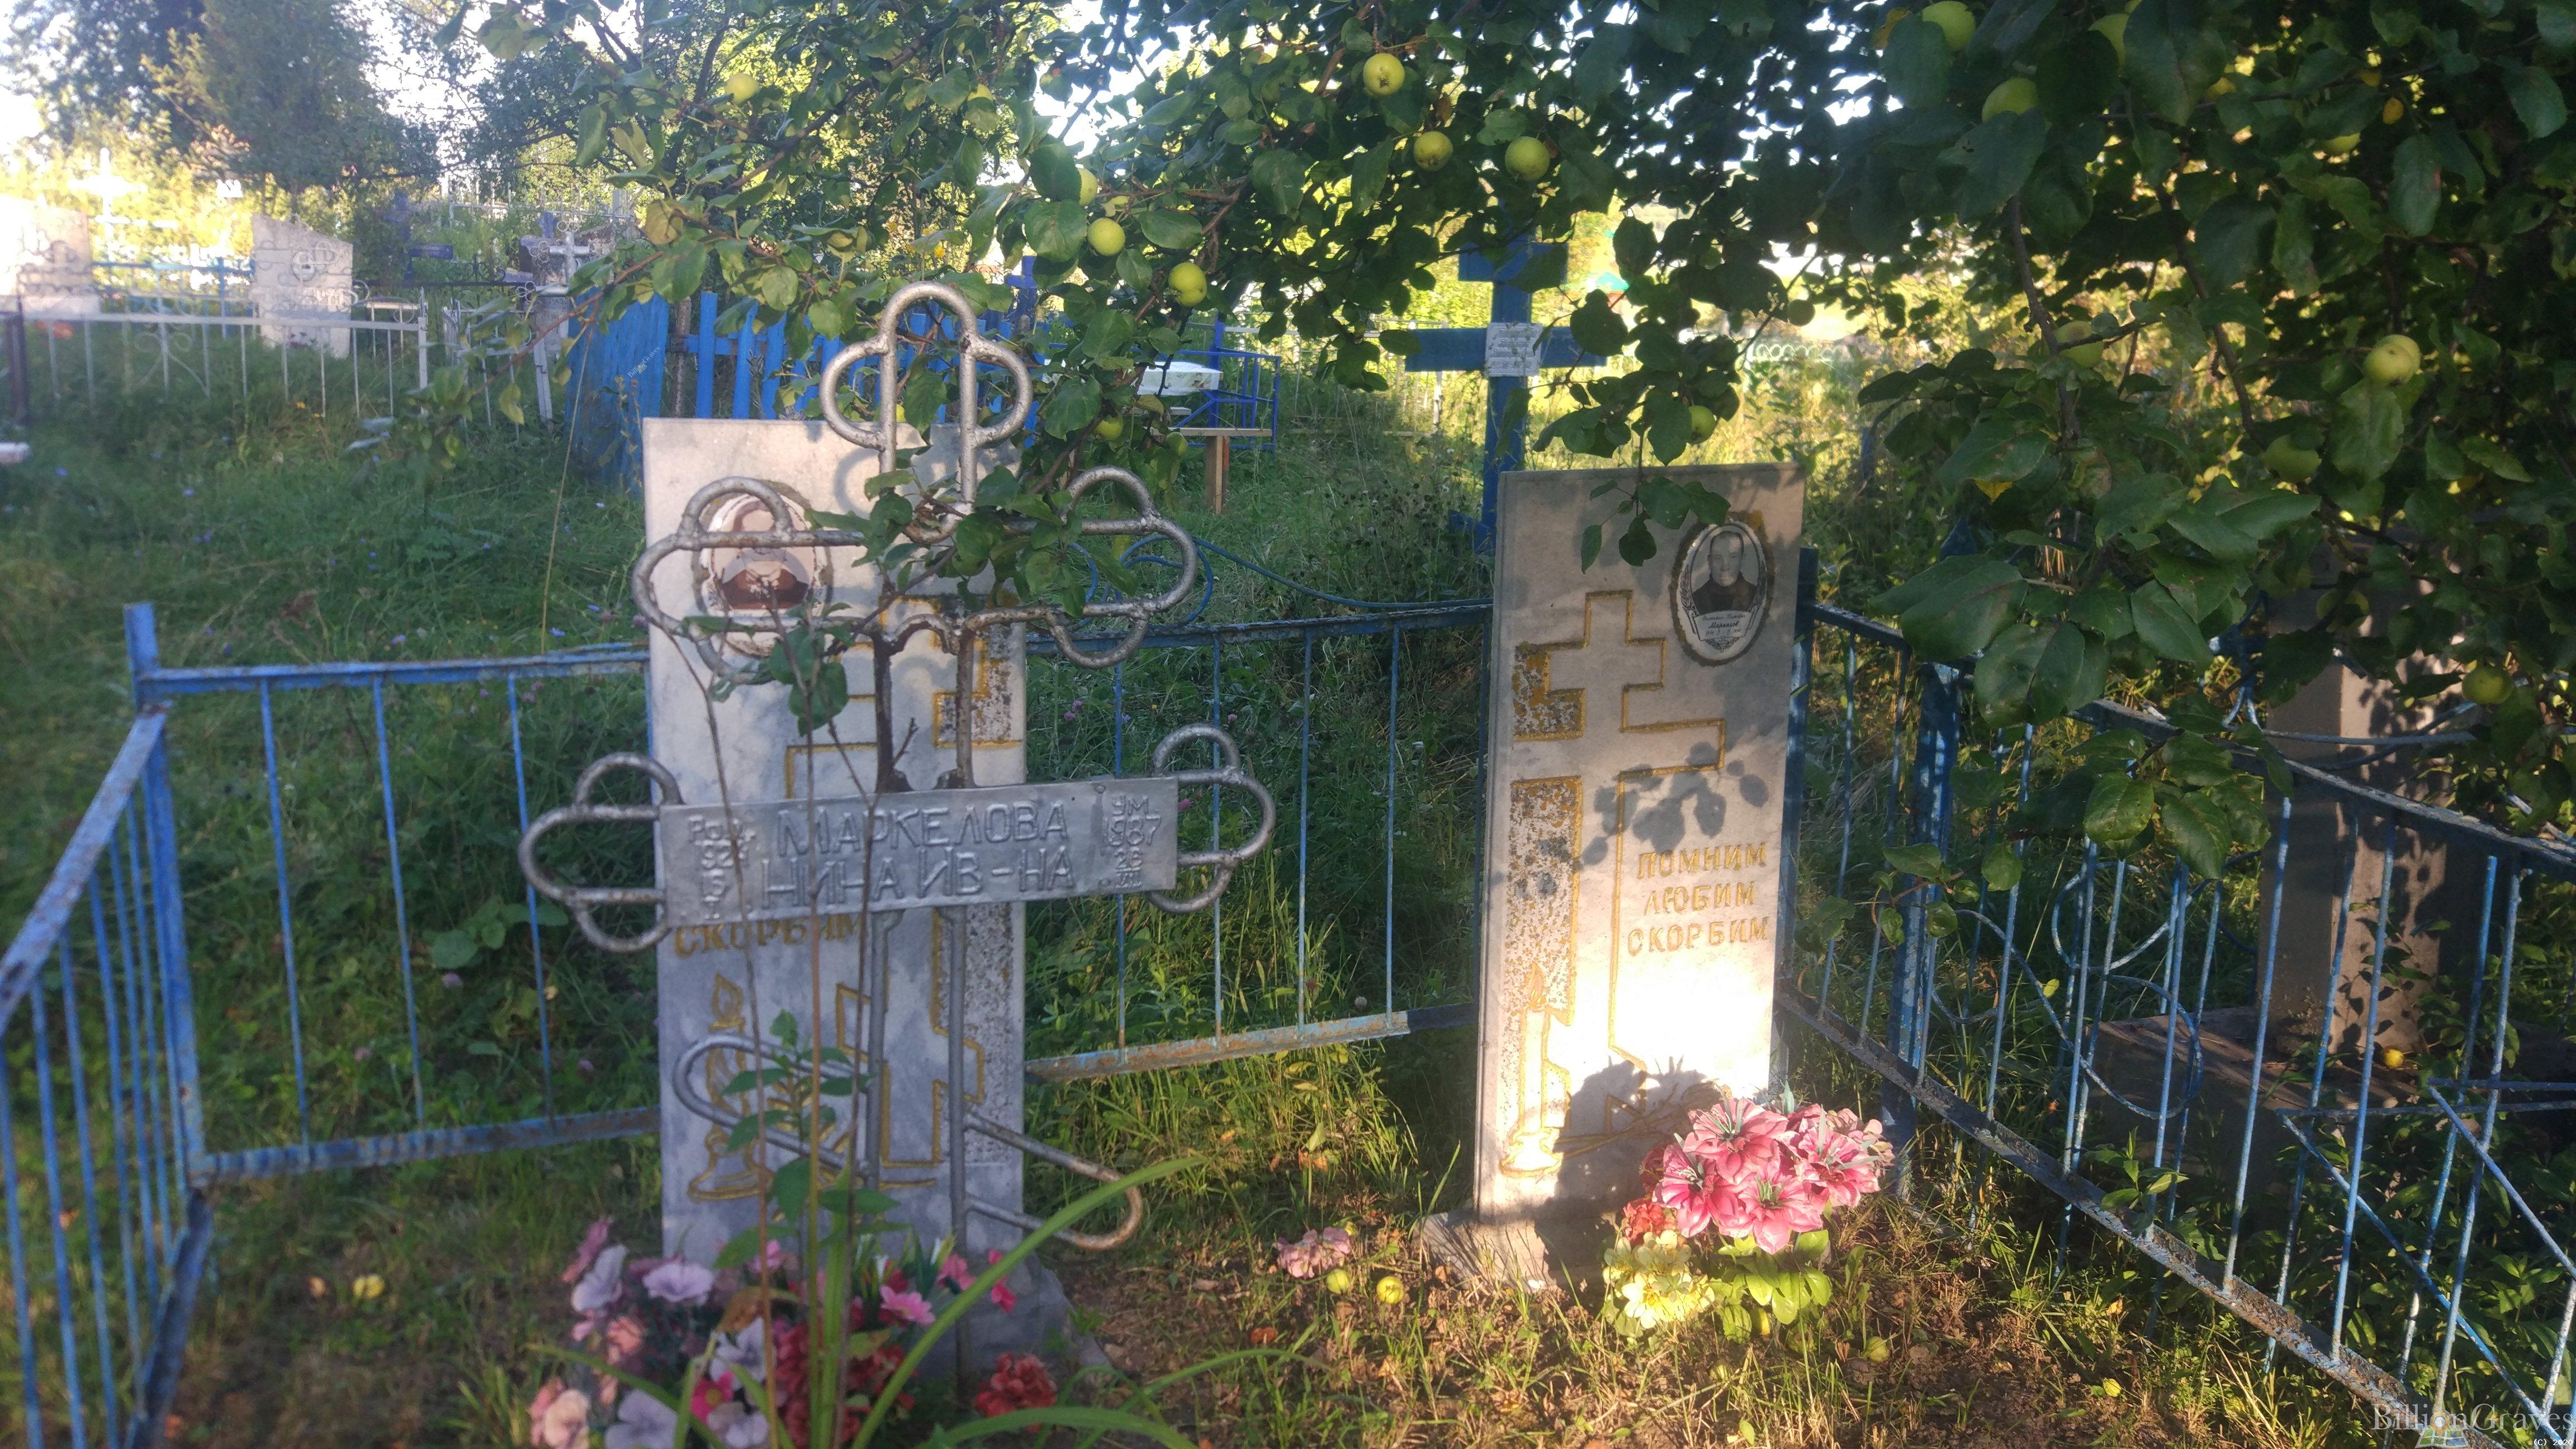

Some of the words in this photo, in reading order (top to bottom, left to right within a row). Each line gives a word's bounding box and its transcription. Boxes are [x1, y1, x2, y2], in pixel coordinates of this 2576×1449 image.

[777, 800, 1068, 857] МАРКЕЛОВА
[1103, 815, 1162, 847] 1987
[761, 857, 905, 910] НИНА
[917, 845, 1076, 899] ИВ-НА
[1637, 842, 1767, 879] ПОМНИМ
[1644, 881, 1756, 915] ЛЮБИМ
[1628, 916, 1769, 956] СКОРБИМ
